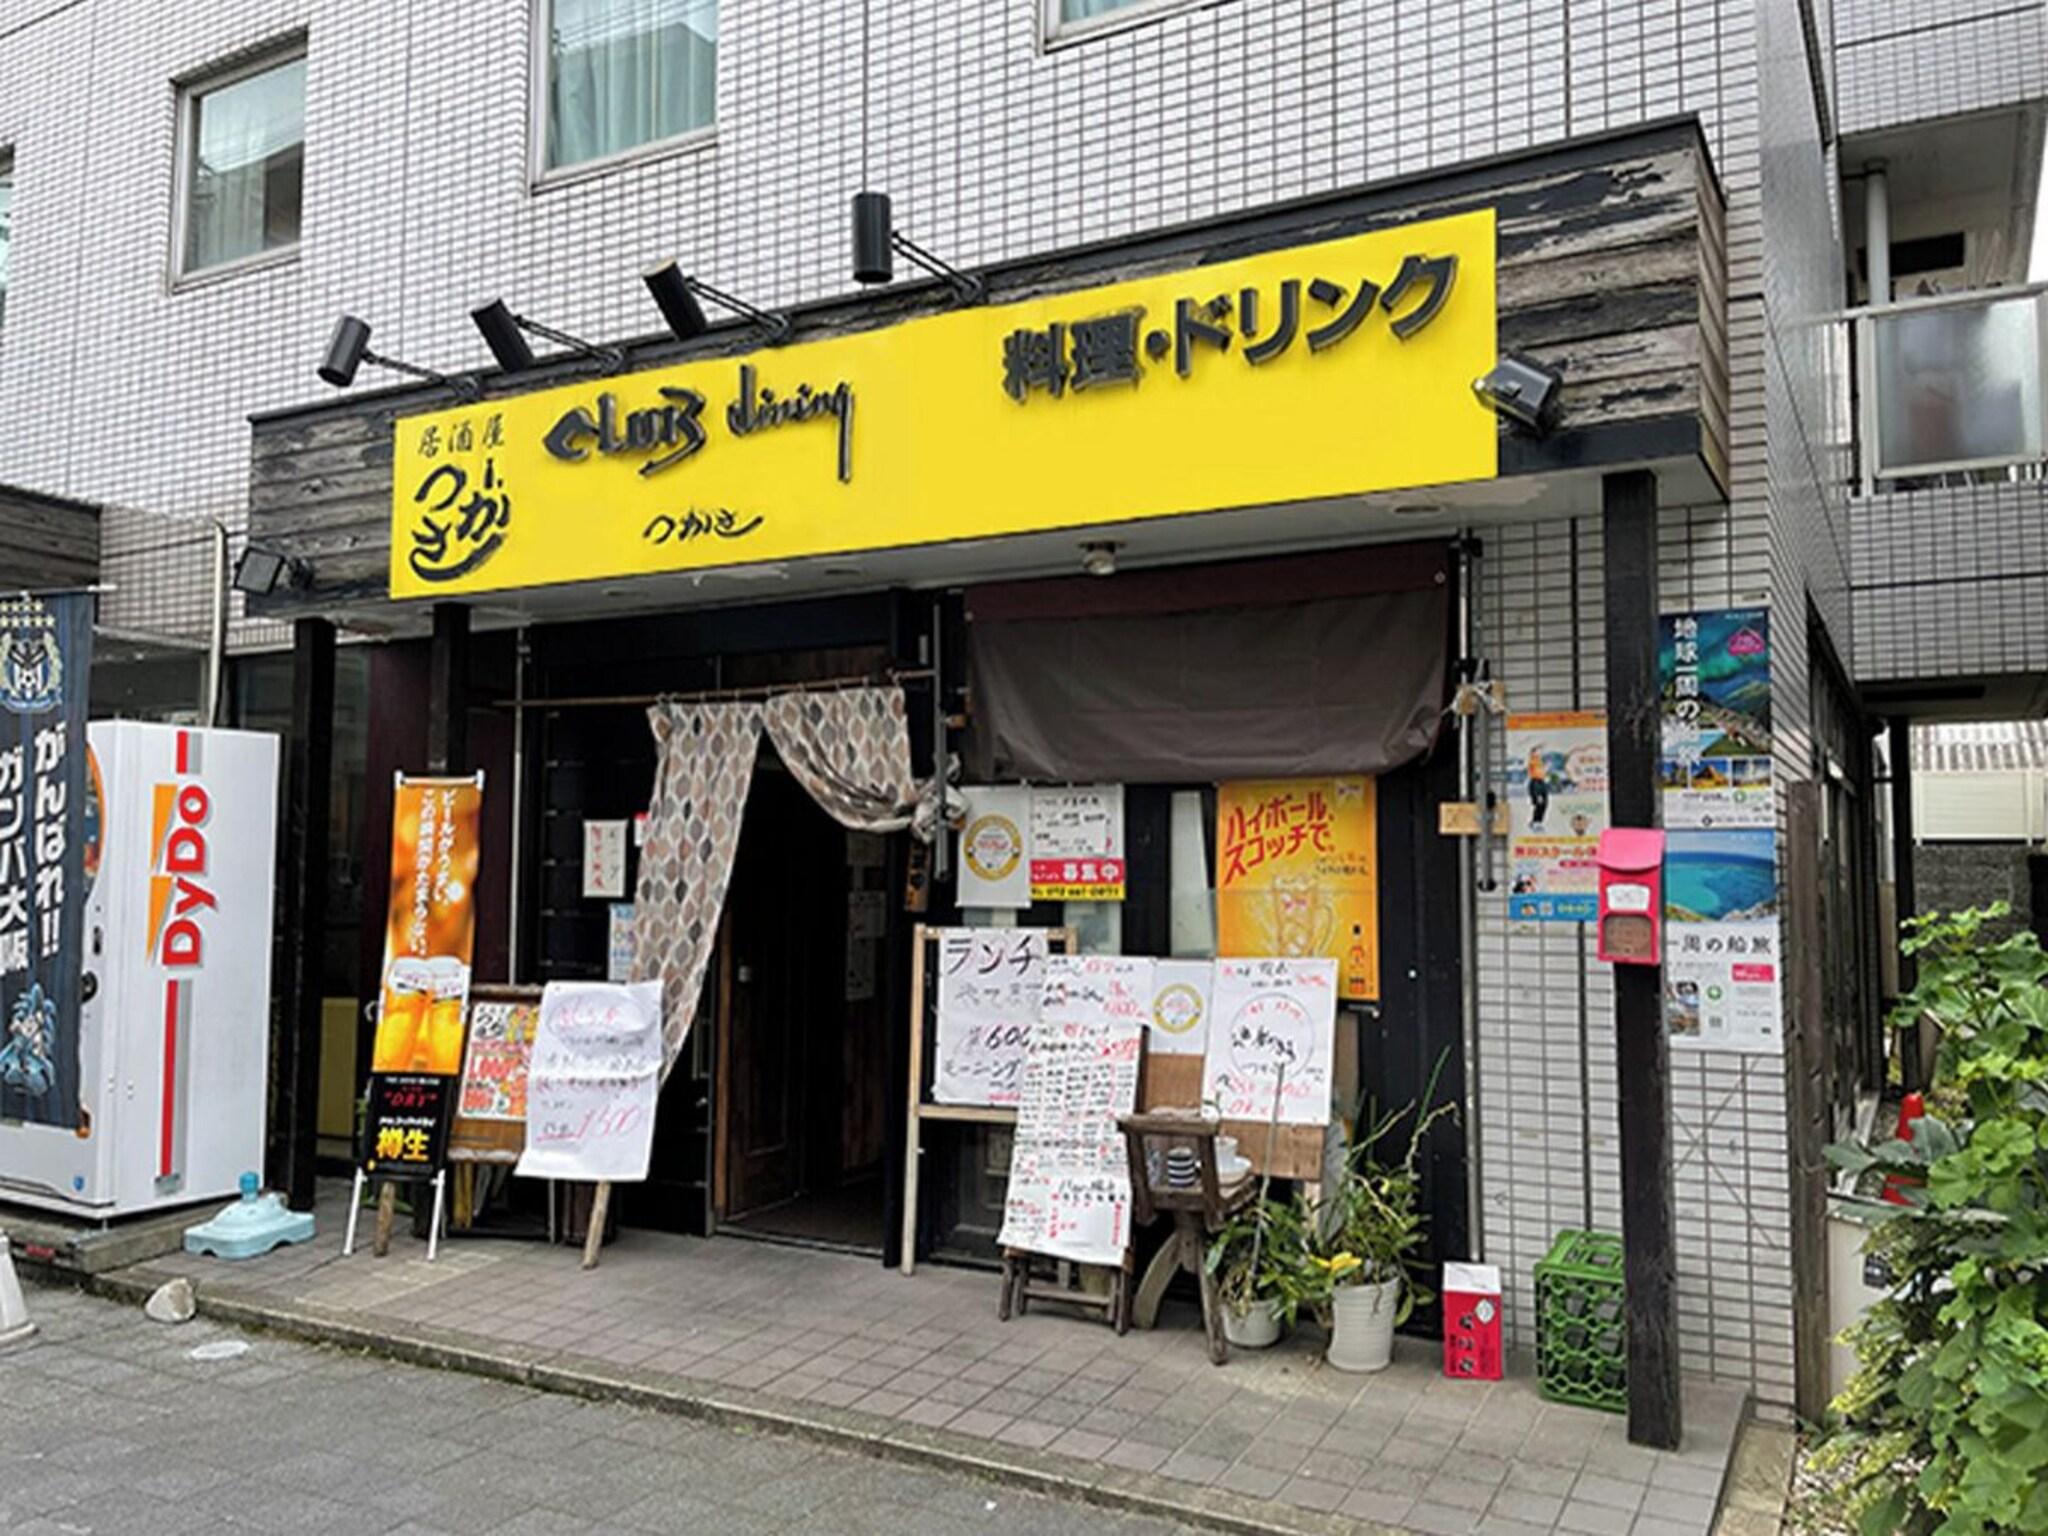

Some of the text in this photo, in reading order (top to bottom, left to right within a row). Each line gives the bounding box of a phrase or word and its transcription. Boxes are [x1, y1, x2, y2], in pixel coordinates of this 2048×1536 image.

[1001, 253, 1459, 405] 料理・ドリンク
[418, 413, 504, 458] 居酒屋
[162, 784, 219, 968] DyDo
[946, 935, 1042, 976] ランチ
[376, 1127, 431, 1161] 樽生
